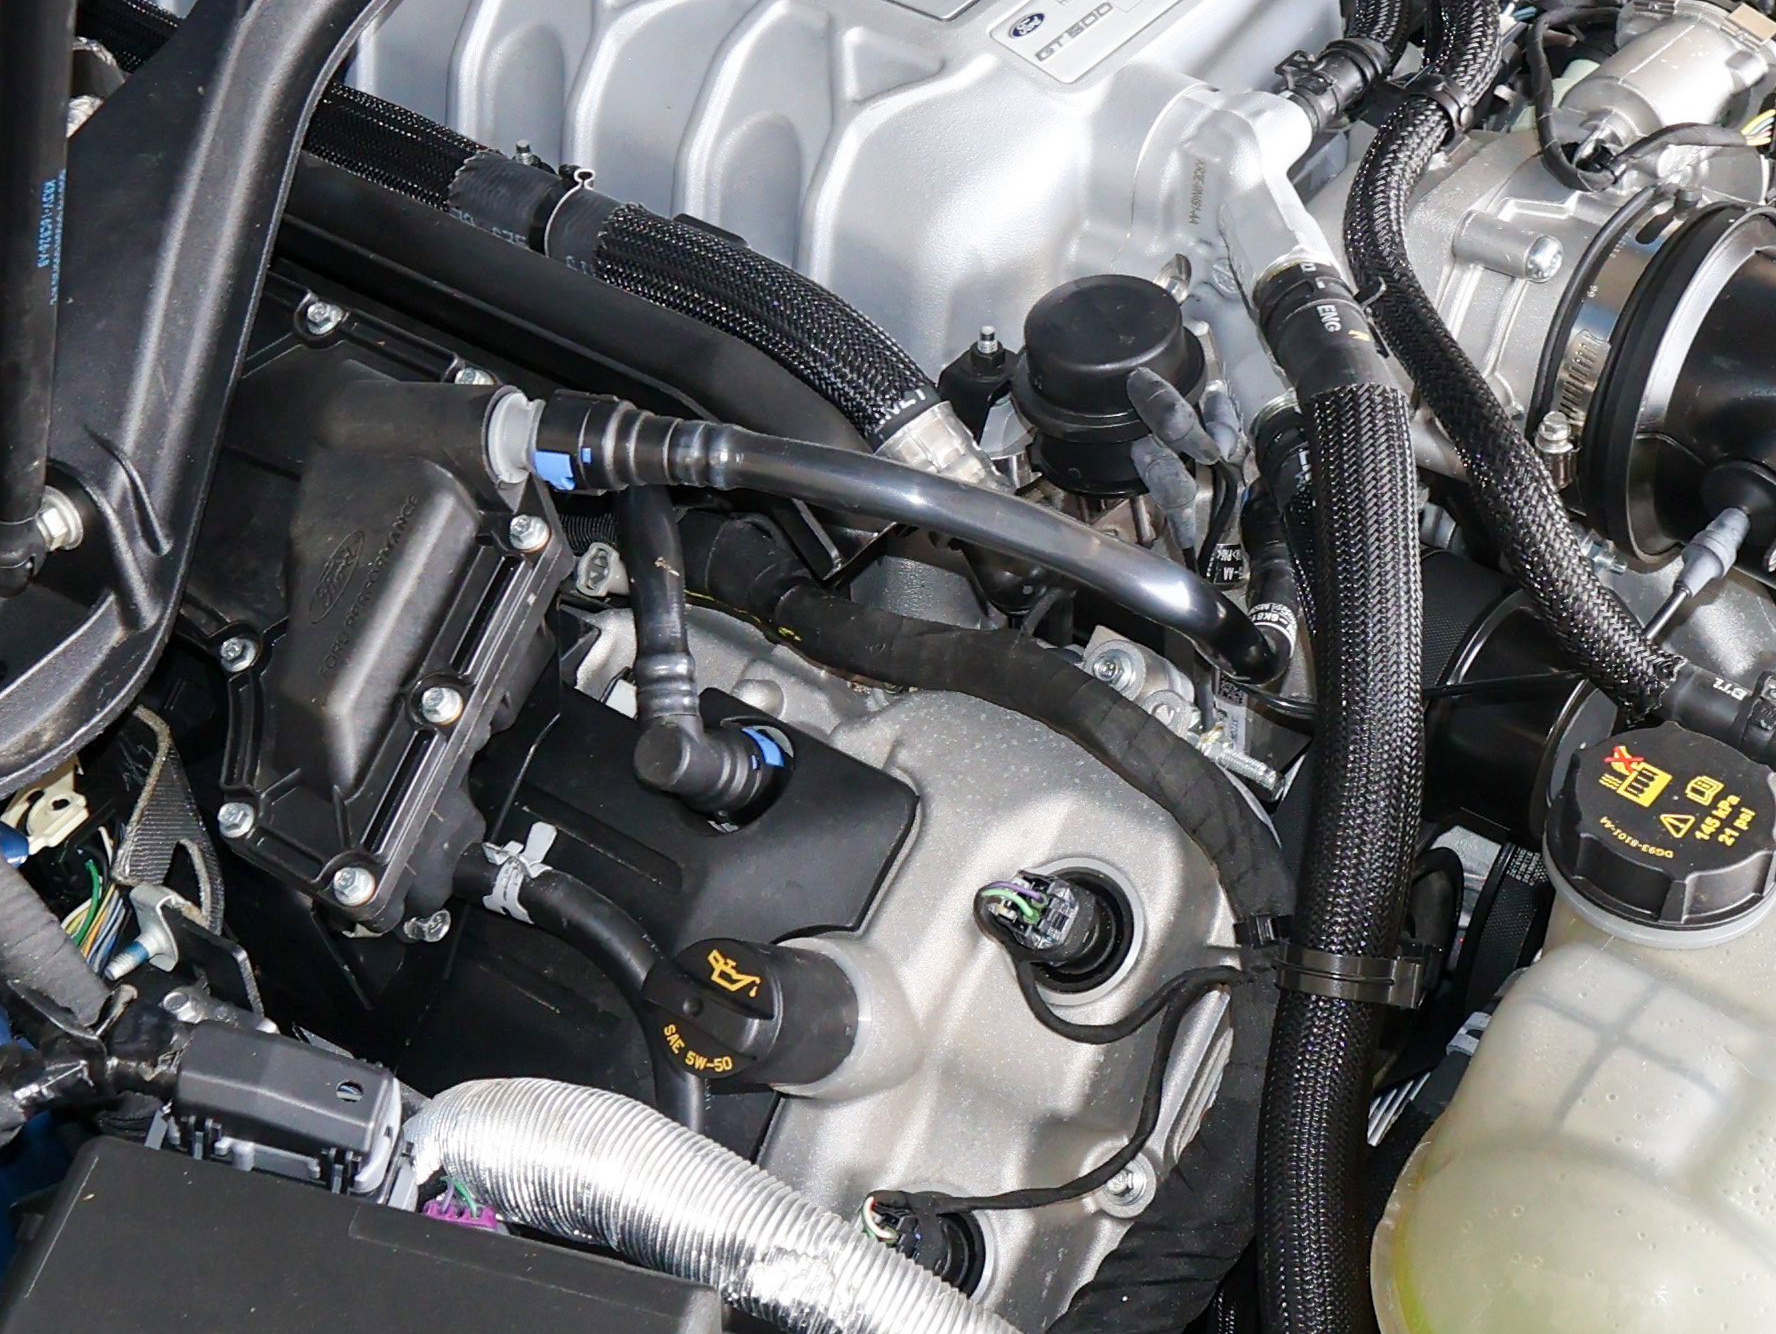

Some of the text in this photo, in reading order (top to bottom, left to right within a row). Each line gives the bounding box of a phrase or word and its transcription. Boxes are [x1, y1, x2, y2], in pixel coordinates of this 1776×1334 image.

[1316, 304, 1342, 332] ENG
[1694, 795, 1740, 842] 145 kPa
[1719, 808, 1756, 846] 21 psi
[664, 1024, 733, 1073] SAE 5W-50
